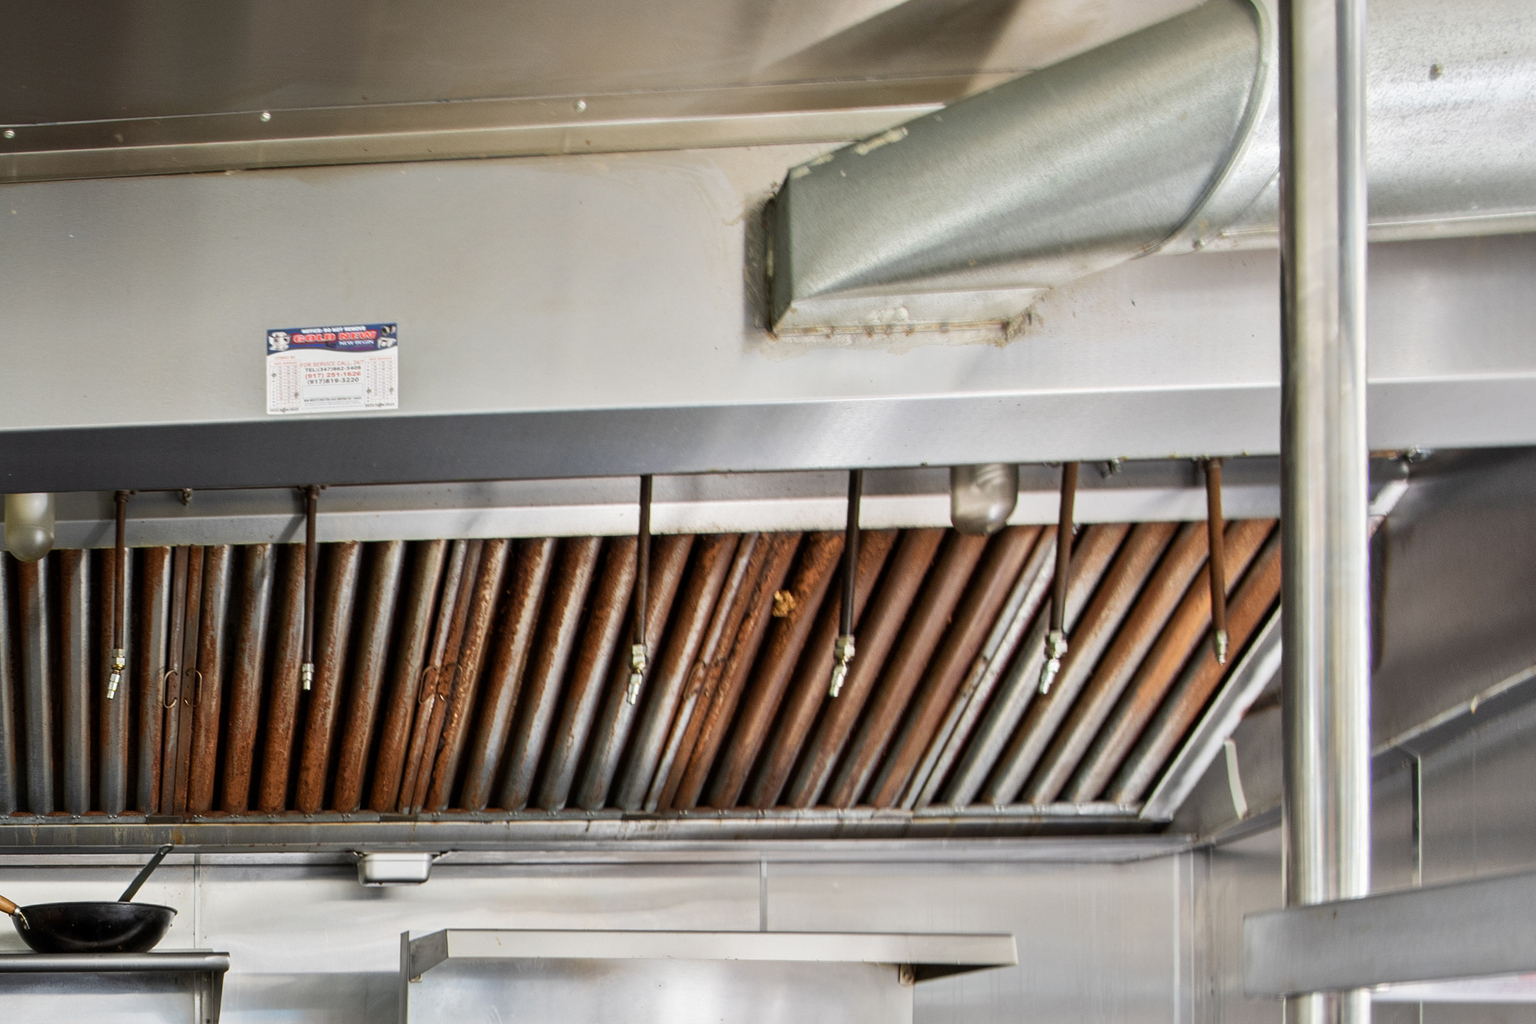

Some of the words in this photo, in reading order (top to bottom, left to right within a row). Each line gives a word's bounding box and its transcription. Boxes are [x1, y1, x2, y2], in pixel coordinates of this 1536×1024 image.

[293, 332, 336, 343] GOLD
[338, 330, 377, 341] NEW
[305, 372, 325, 380] (917)
